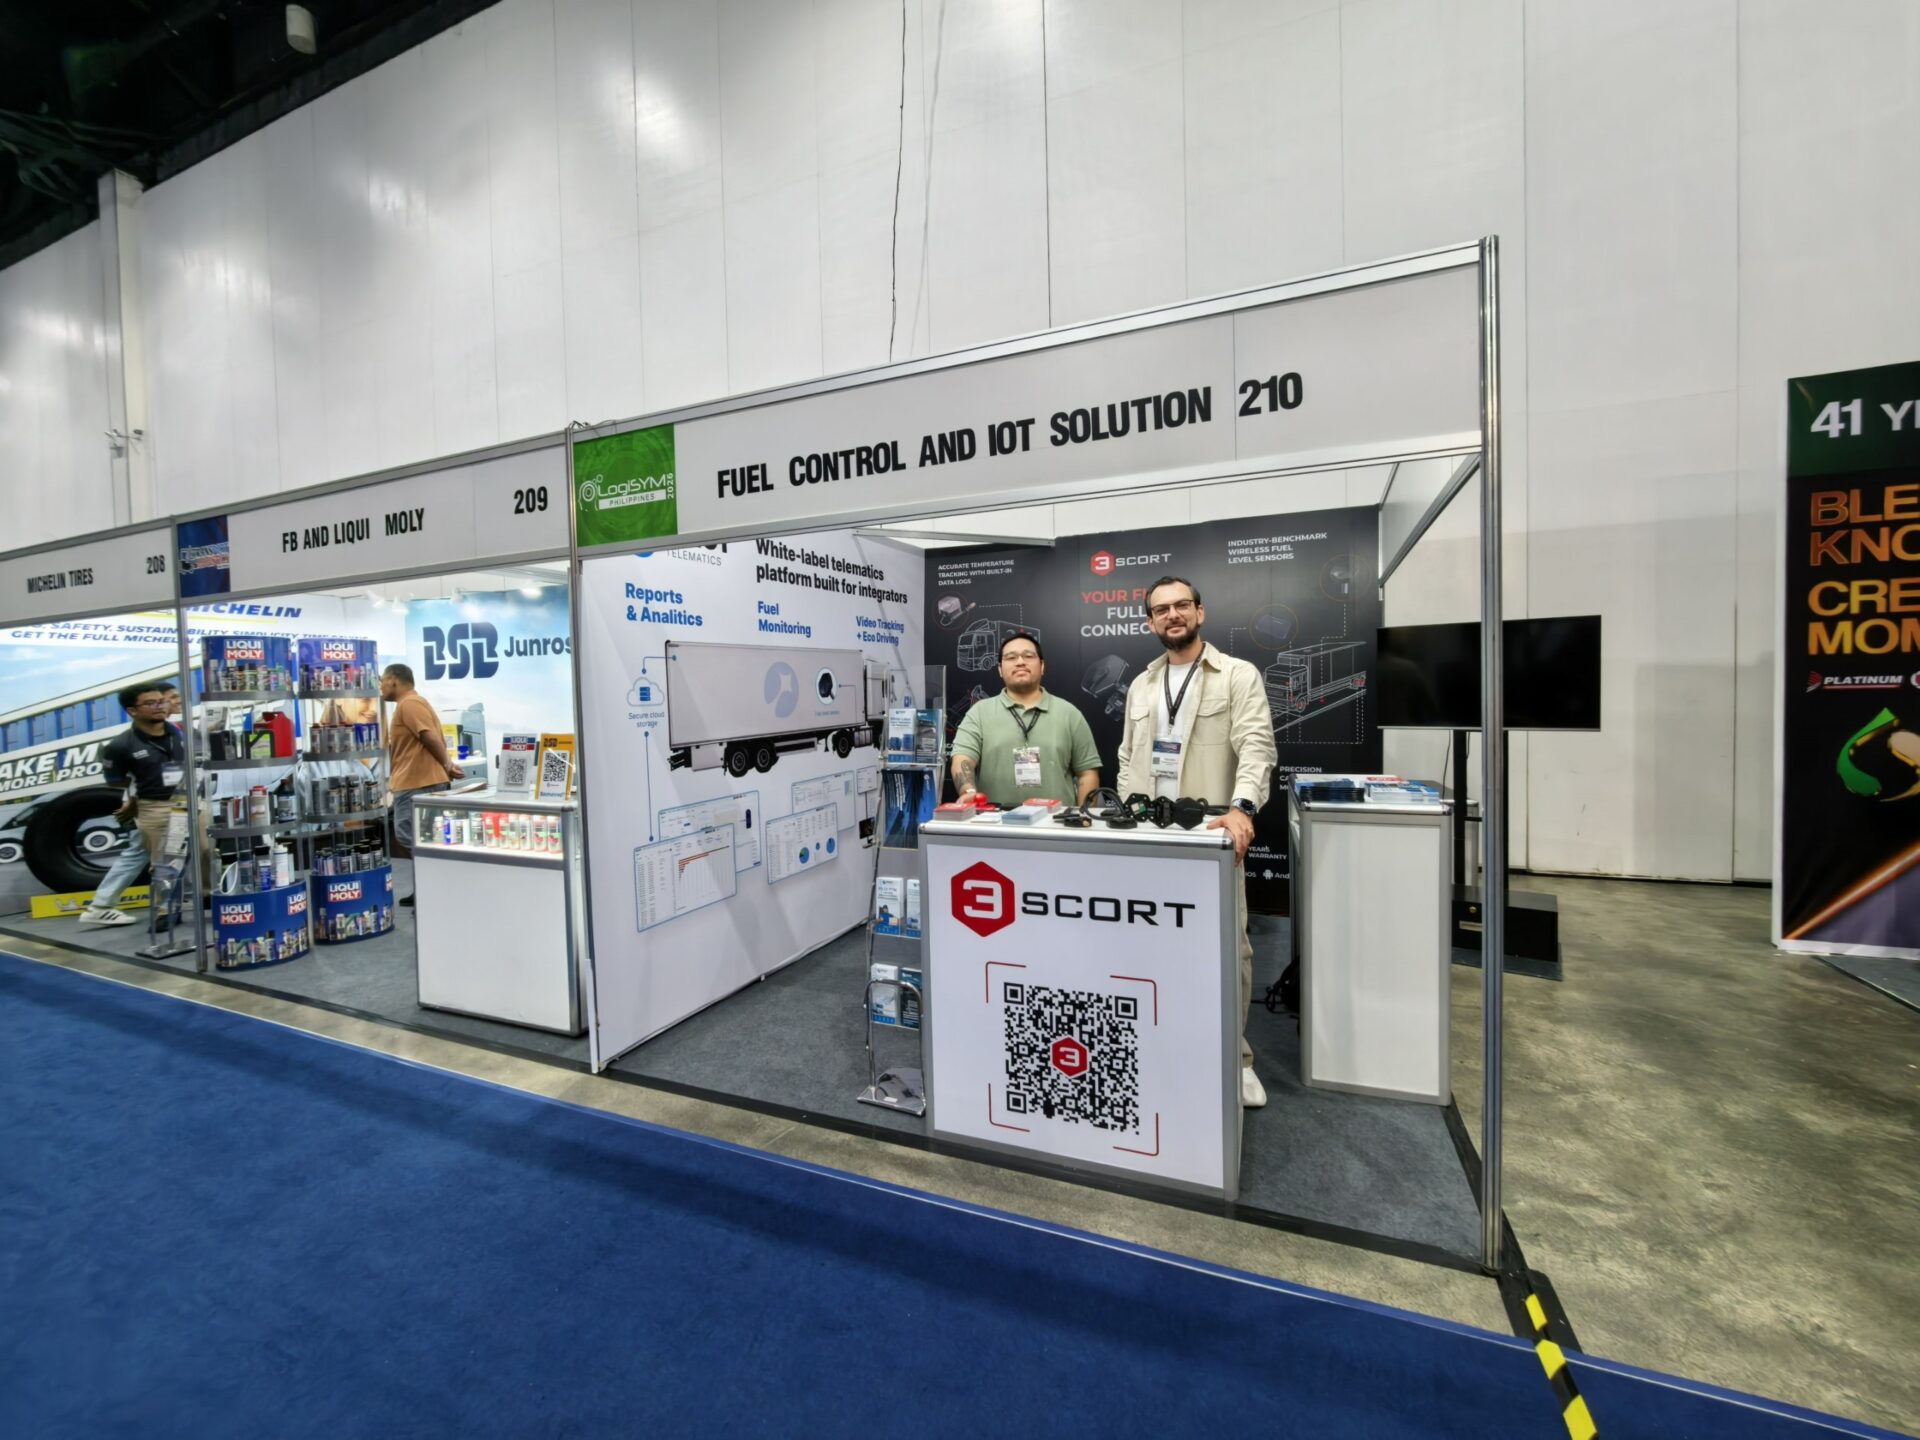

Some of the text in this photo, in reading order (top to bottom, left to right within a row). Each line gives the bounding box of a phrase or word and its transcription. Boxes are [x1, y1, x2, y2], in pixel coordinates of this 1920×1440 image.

[1810, 398, 1862, 438] 41
[717, 372, 1303, 498] FUEL CONTROL AND IOT SOLUTION 210
[609, 493, 655, 506] PHILIPPINES
[282, 486, 548, 552] FB AND LIQUI MOLY 209
[1228, 532, 1327, 547] INDUSTRY-BENCHMARK
[1228, 546, 1269, 555] WIRELESS
[756, 538, 829, 569] White-label
[831, 556, 884, 581] telematics
[1228, 553, 1294, 564] LEVEL SENSORS
[27, 555, 166, 594] MICHELIN TIRES 208
[756, 563, 908, 604] platform built for integrators
[625, 582, 683, 604] Reports
[1082, 589, 1127, 604] YOUR
[758, 600, 779, 615] Fuel
[627, 605, 703, 626] & Analitics
[758, 618, 811, 638] Monitoring
[856, 616, 904, 633] Video Tracking
[12, 631, 43, 639] GET
[48, 632, 80, 640] THE
[83, 633, 119, 641] FULL
[863, 631, 876, 642] Eco
[876, 632, 899, 646] Driving
[226, 640, 262, 650] LIQUI
[323, 642, 353, 651] LIQUI
[226, 650, 263, 659] MOLY
[323, 651, 355, 659] MOLY
[1823, 675, 1903, 685] PLATINUM
[330, 882, 359, 892] LIQUI
[330, 890, 361, 900] MOLY
[221, 904, 252, 914] LIQUI
[221, 914, 254, 923] MOLY
